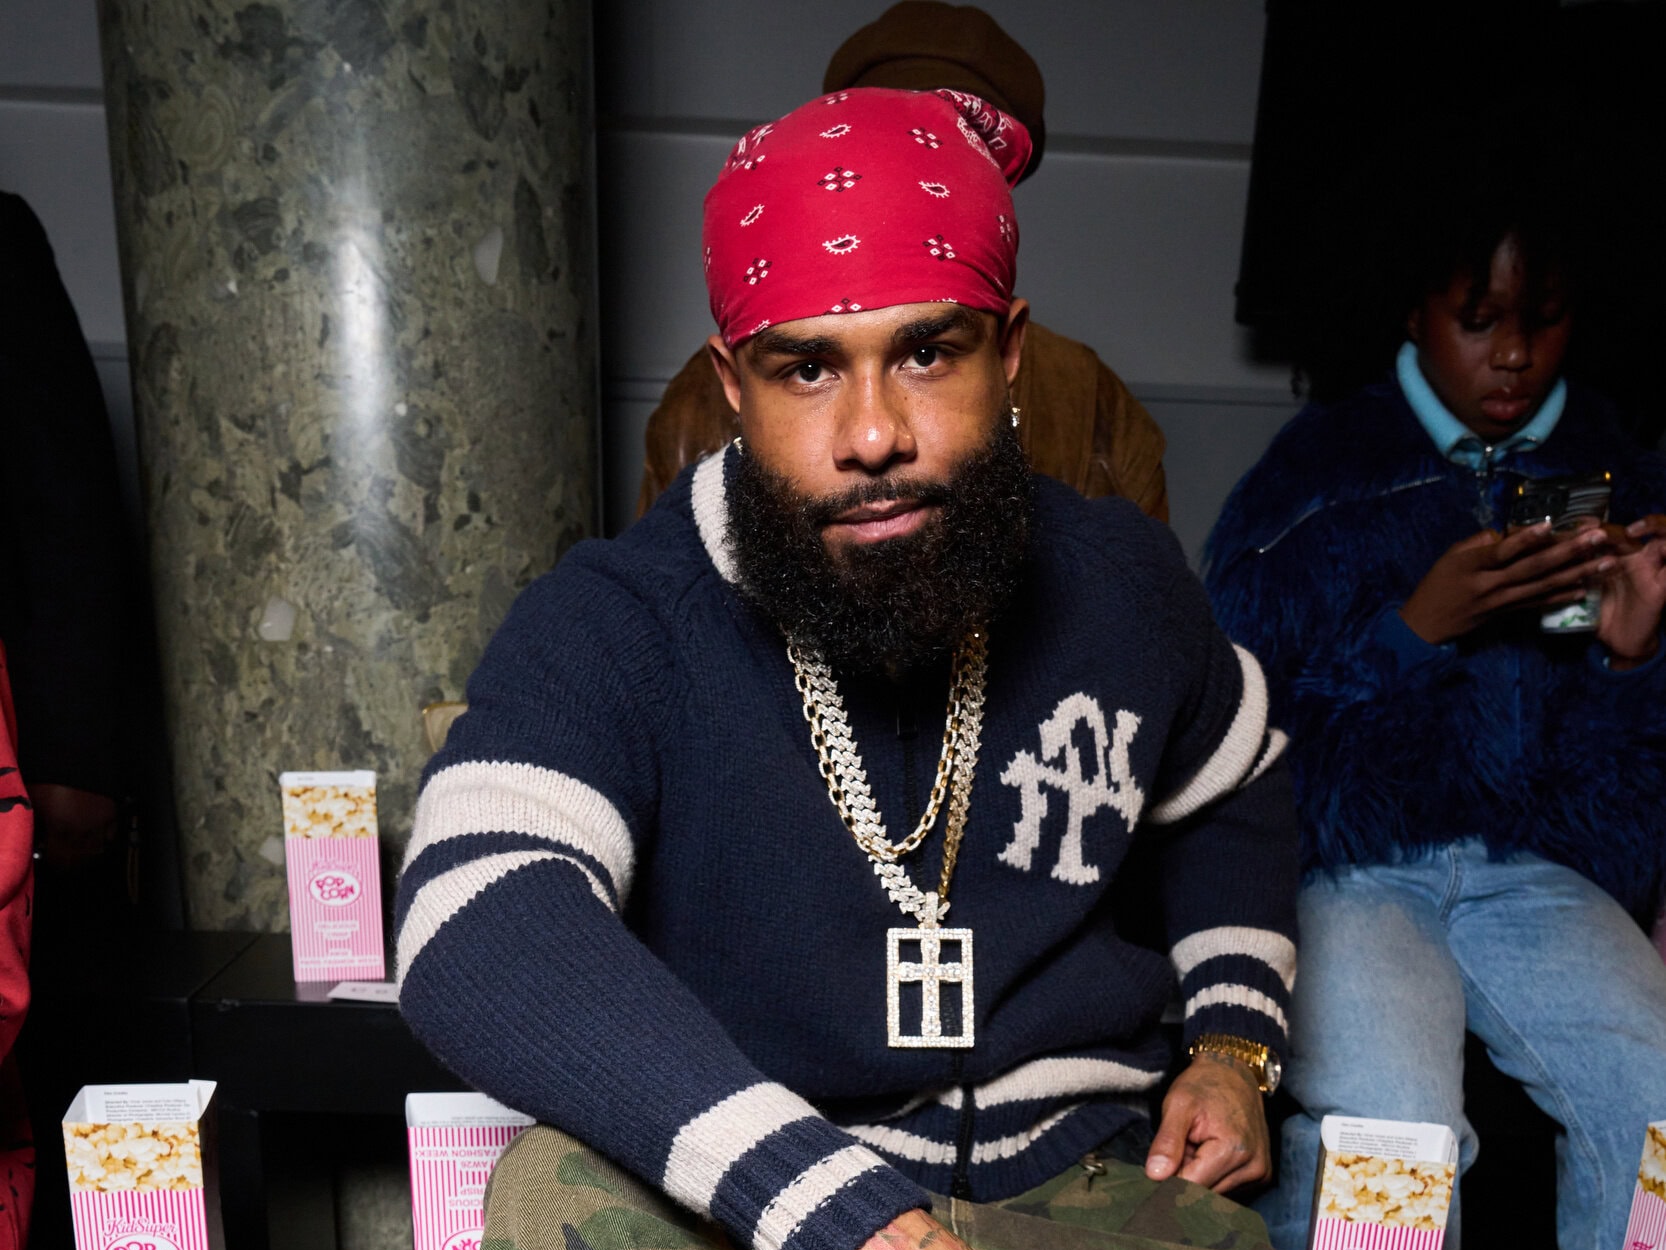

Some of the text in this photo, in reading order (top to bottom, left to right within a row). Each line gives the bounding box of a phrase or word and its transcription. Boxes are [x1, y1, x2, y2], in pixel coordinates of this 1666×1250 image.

[315, 875, 344, 889] POP
[320, 884, 354, 900] CORN
[417, 1149, 449, 1158] WEEK
[452, 1149, 497, 1158] FASHION
[460, 1187, 484, 1196] RISP
[104, 1217, 176, 1237] KidSuper
